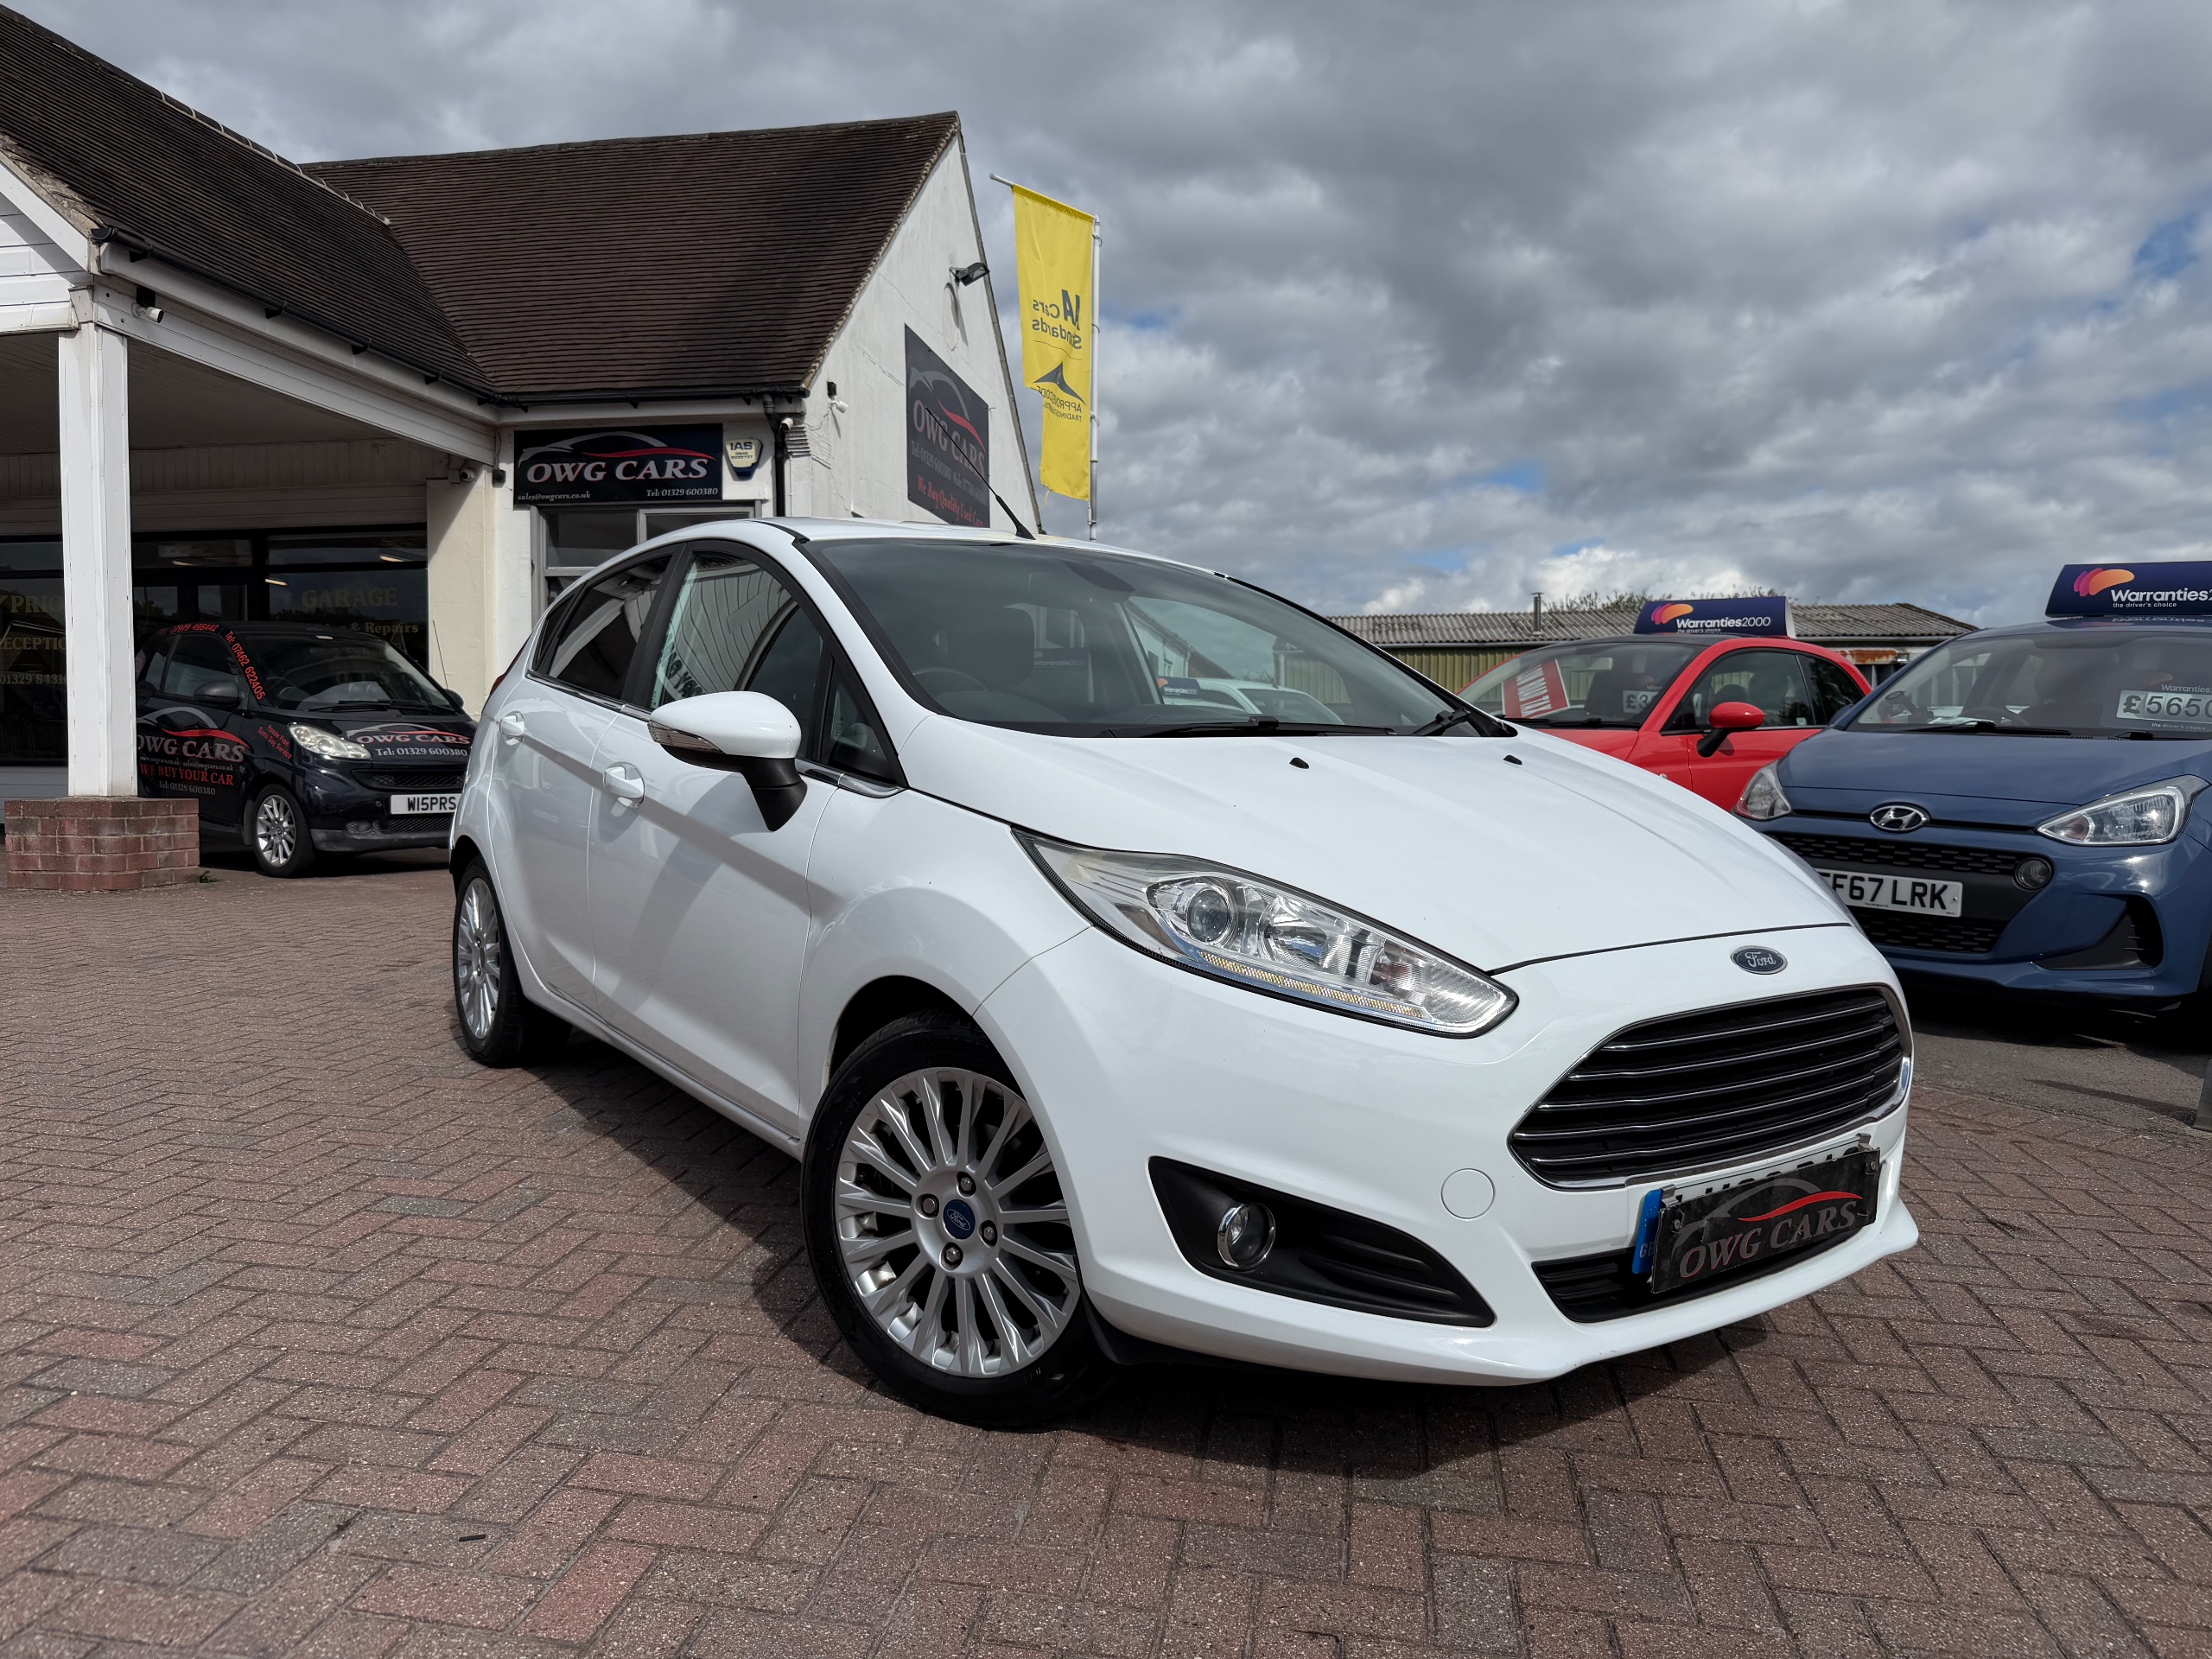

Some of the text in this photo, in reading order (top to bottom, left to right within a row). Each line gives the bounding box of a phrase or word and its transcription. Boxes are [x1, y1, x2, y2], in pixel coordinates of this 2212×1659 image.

[731, 442, 753, 450] IAS
[912, 399, 985, 483] OWG CARS
[527, 459, 709, 483] OWG CARS
[518, 491, 591, 502] sales@owgcars.co.uk
[646, 487, 718, 498] Tel: 01329 600380
[918, 475, 926, 494] We
[928, 483, 939, 508] Buy
[939, 490, 960, 522] Quality
[302, 588, 397, 607] GARAGE
[365, 621, 419, 636] Repairs
[1676, 616, 1771, 629] Warranties2000
[225, 631, 266, 700] Tel: 07462 622405
[356, 734, 471, 745] OWG CARS
[182, 741, 245, 763] CARS
[397, 747, 427, 756] 01329
[429, 747, 468, 757] 600380
[140, 764, 234, 786] WE BUY YOUR CAR
[170, 782, 188, 792] 01329
[189, 785, 216, 795] 600380
[1891, 880, 1948, 910] LRK
[1745, 951, 1777, 968] Ford
[950, 1211, 967, 1228] Ford
[1680, 1200, 1858, 1278] OWG CARS
